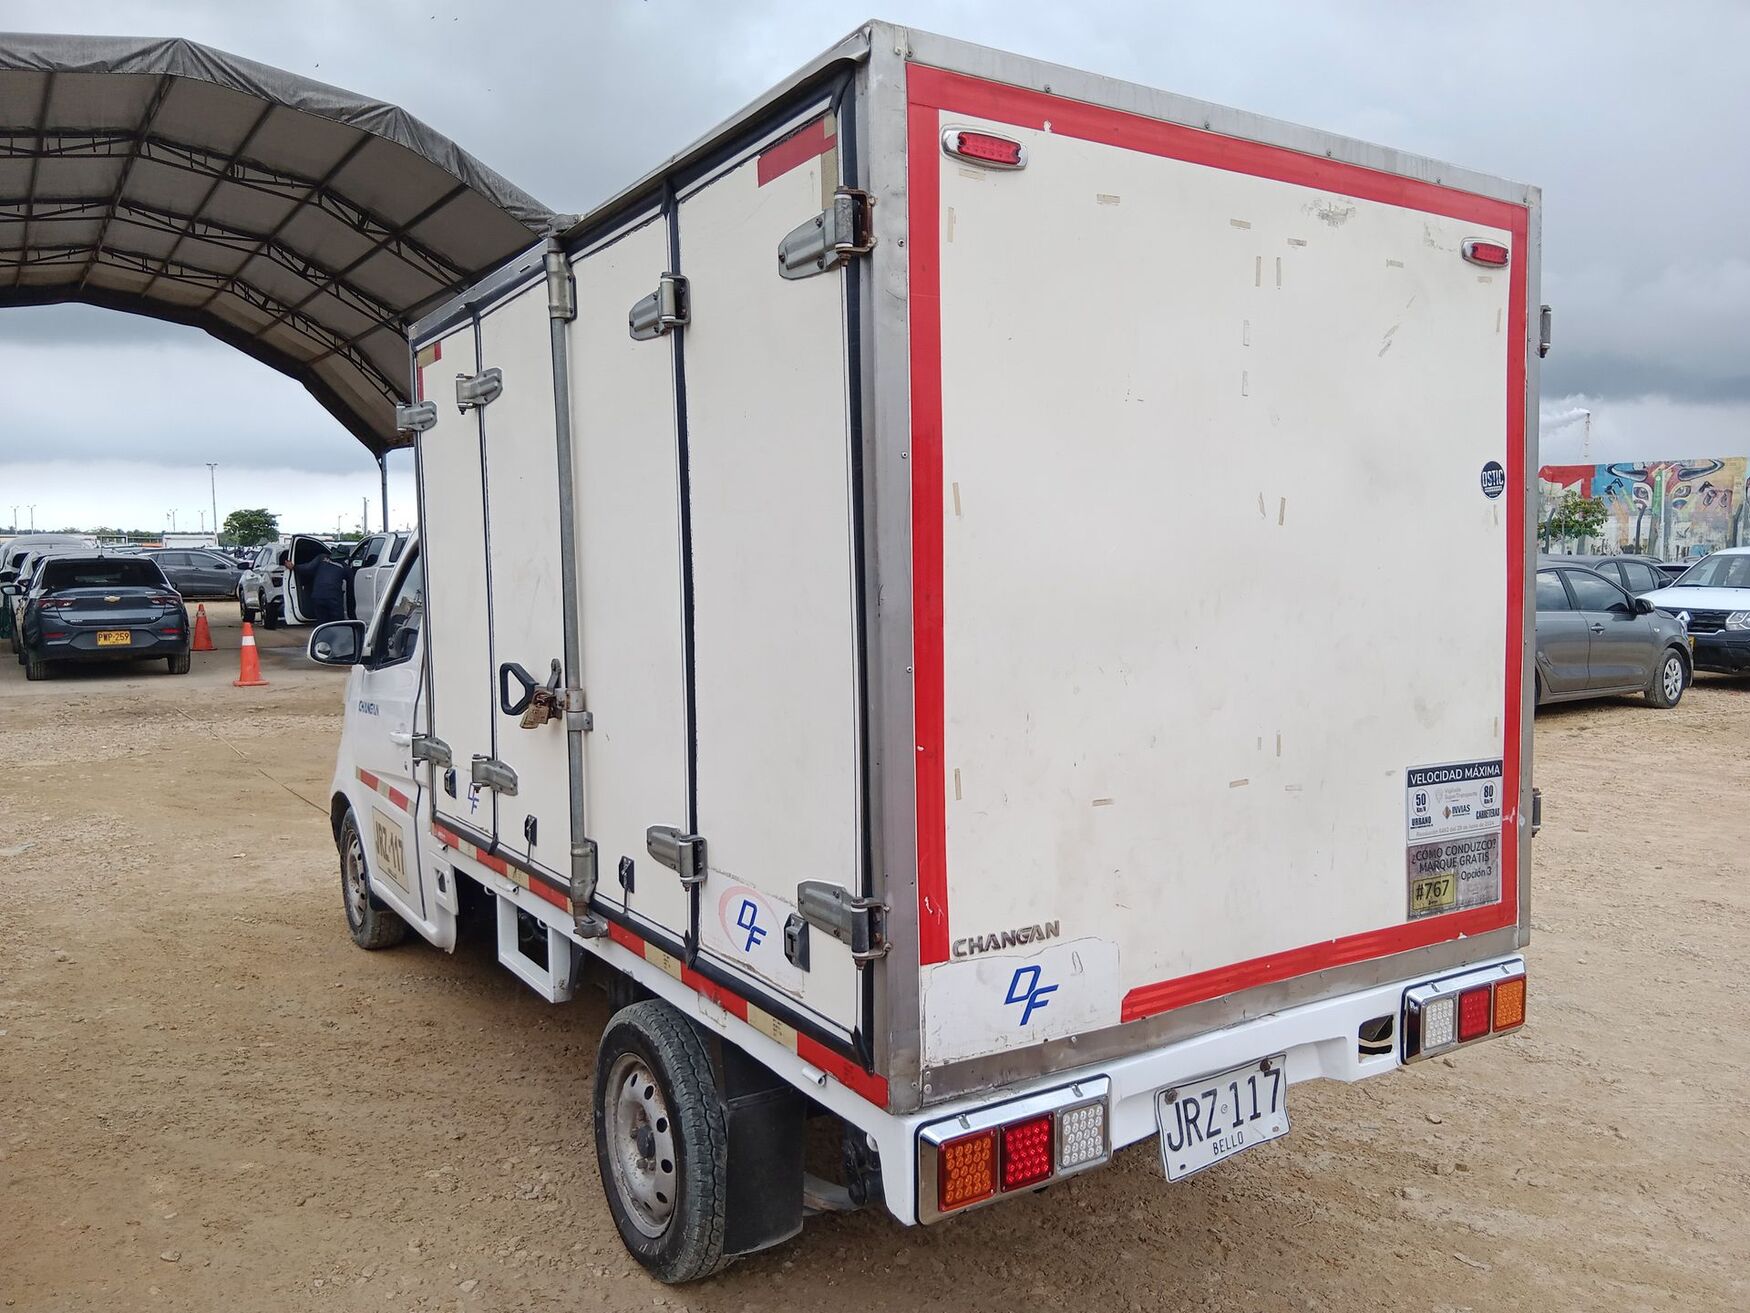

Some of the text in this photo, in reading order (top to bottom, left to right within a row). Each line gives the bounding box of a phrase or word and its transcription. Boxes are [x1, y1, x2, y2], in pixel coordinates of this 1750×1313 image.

[1410, 763, 1500, 785] VELOCIDAD MÁXIMA
[1415, 793, 1427, 806] 50
[1483, 785, 1494, 798] 80
[1444, 838, 1497, 857] CONDUZCO?
[1419, 851, 1490, 873] MARQUE GRATIS
[1460, 866, 1492, 881] Opción 3
[1416, 879, 1450, 901] #767
[951, 919, 1060, 958] CHANGAN
[1166, 1067, 1281, 1152] JRZ 117
[1212, 1130, 1244, 1156] BELLO
